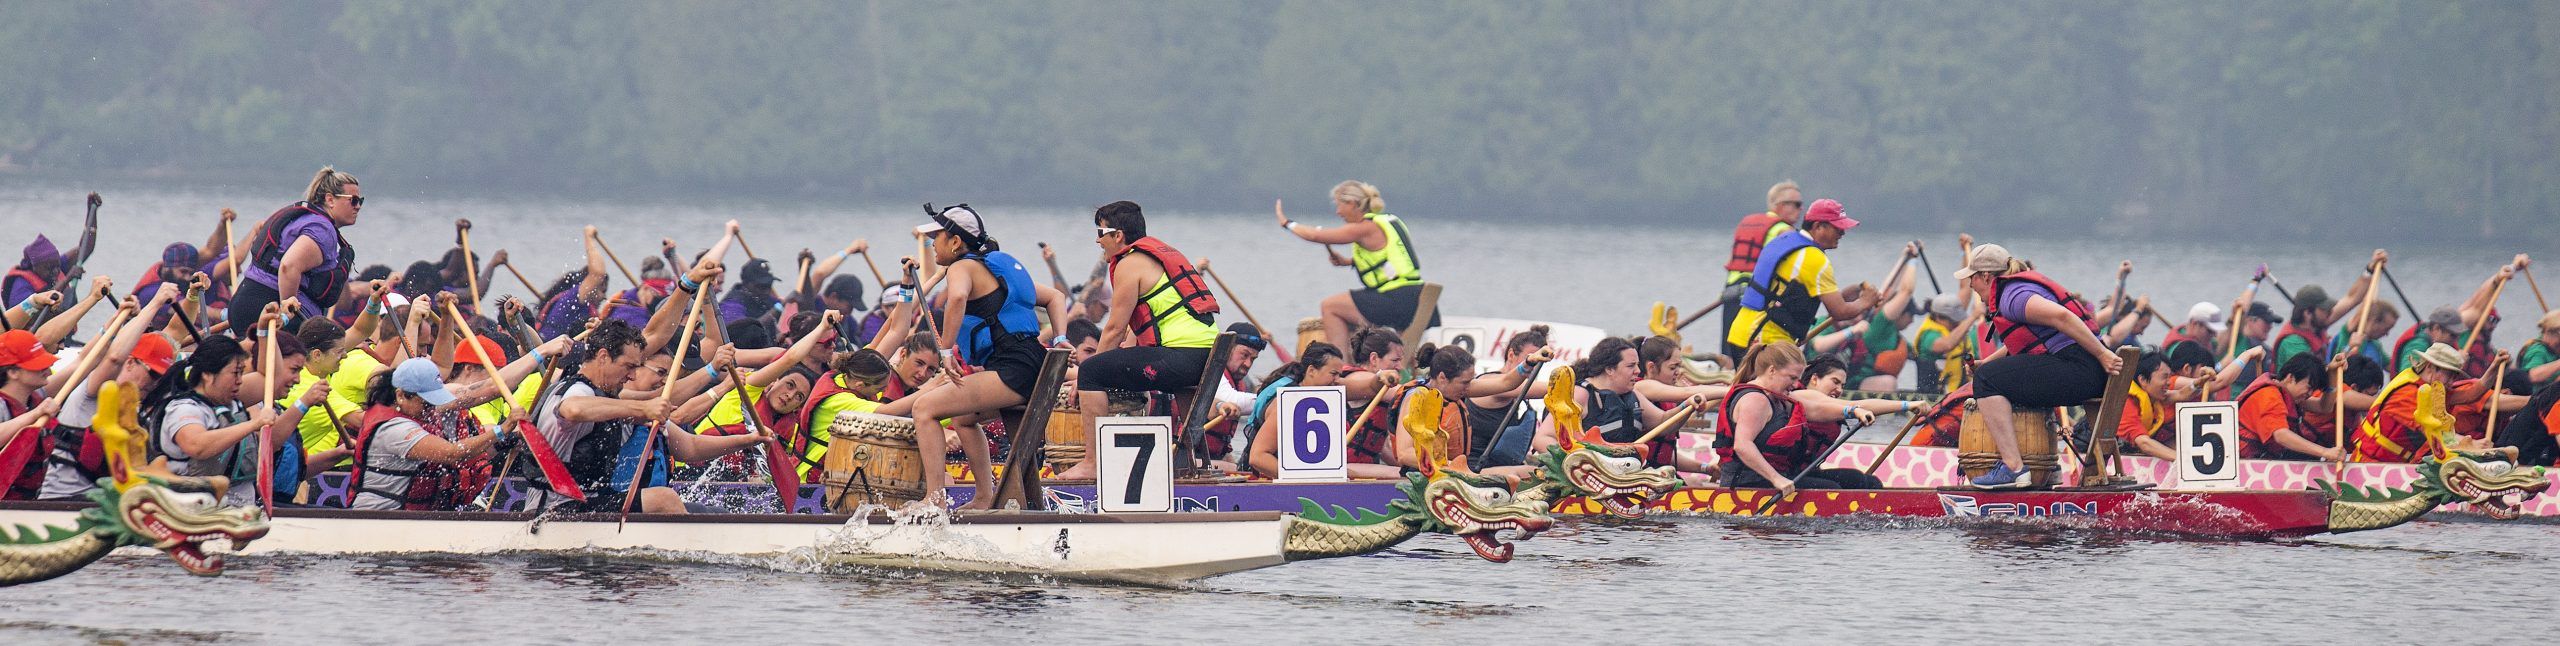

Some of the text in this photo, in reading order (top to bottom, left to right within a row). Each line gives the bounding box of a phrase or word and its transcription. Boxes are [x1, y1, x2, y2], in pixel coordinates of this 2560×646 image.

[1293, 396, 1331, 464] 6
[2191, 413, 2225, 475] 5
[1114, 433, 1156, 504] 7
[1053, 527, 1071, 561] 4
